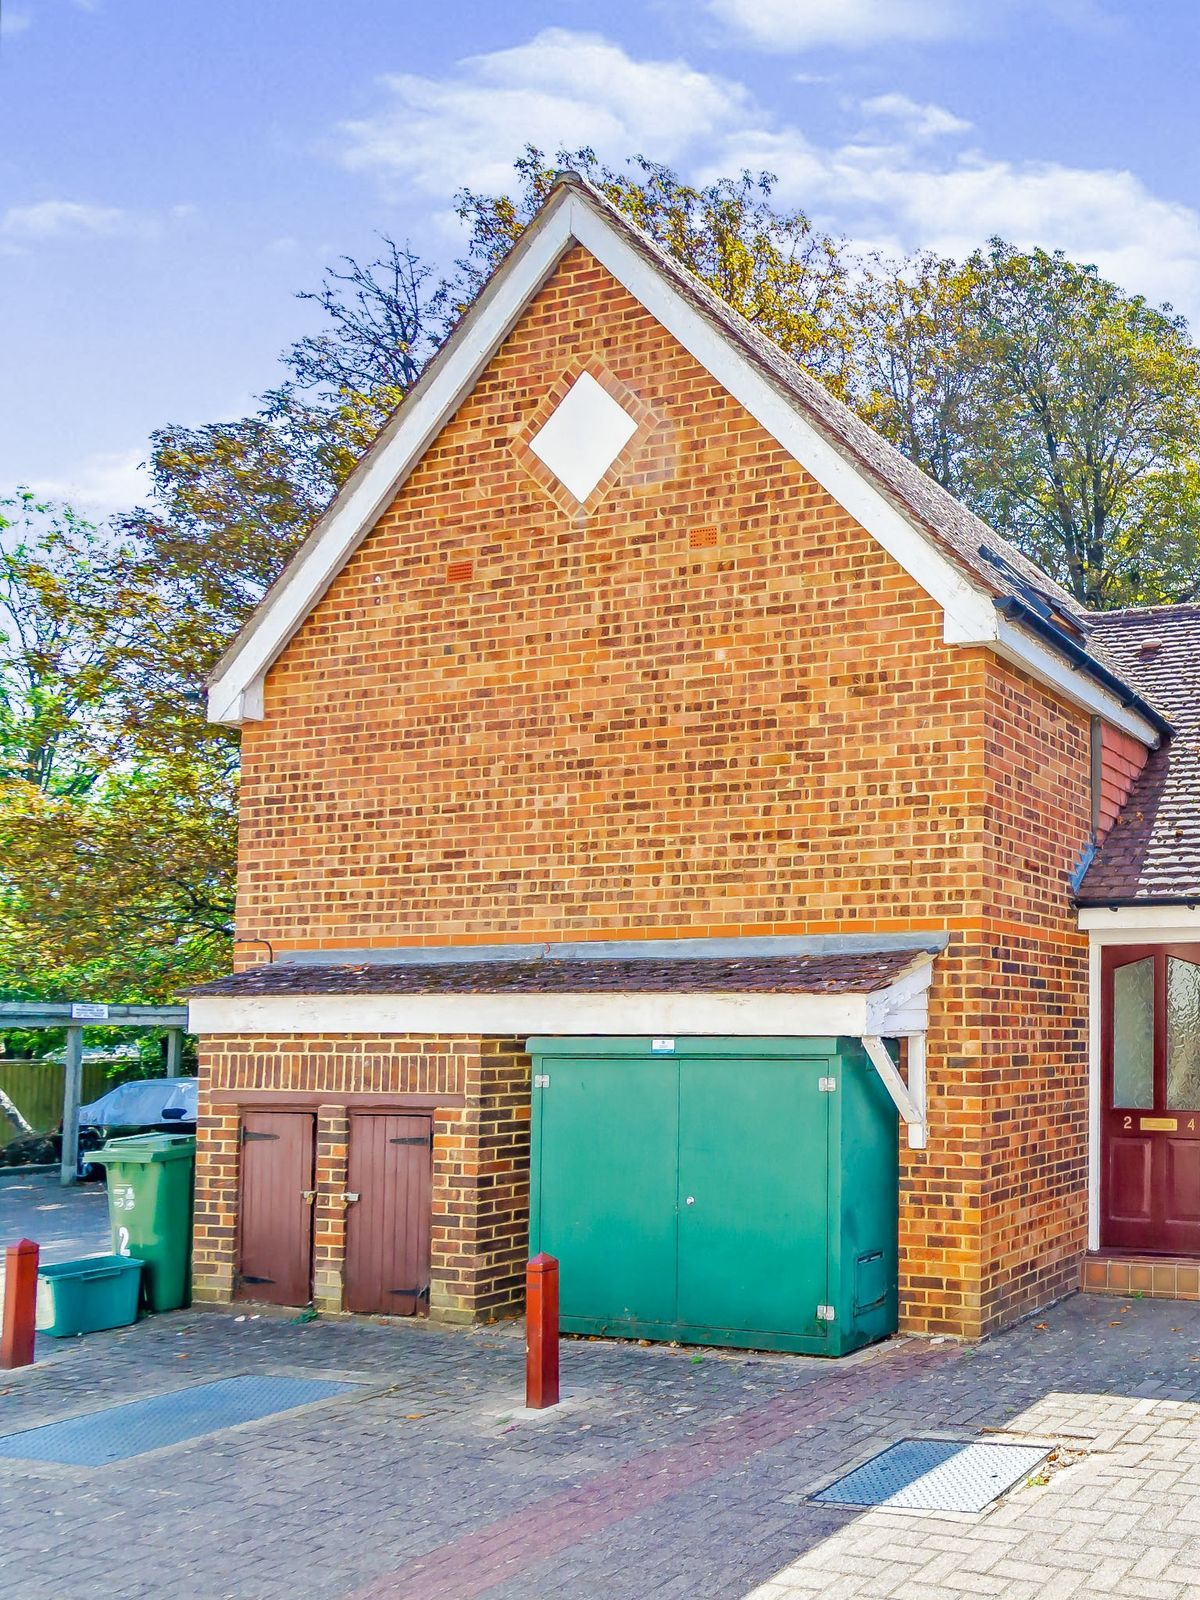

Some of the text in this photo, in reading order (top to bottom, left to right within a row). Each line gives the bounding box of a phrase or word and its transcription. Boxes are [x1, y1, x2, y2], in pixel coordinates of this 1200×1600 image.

[1123, 1115, 1195, 1131] 2 4
[119, 1226, 131, 1256] 2
